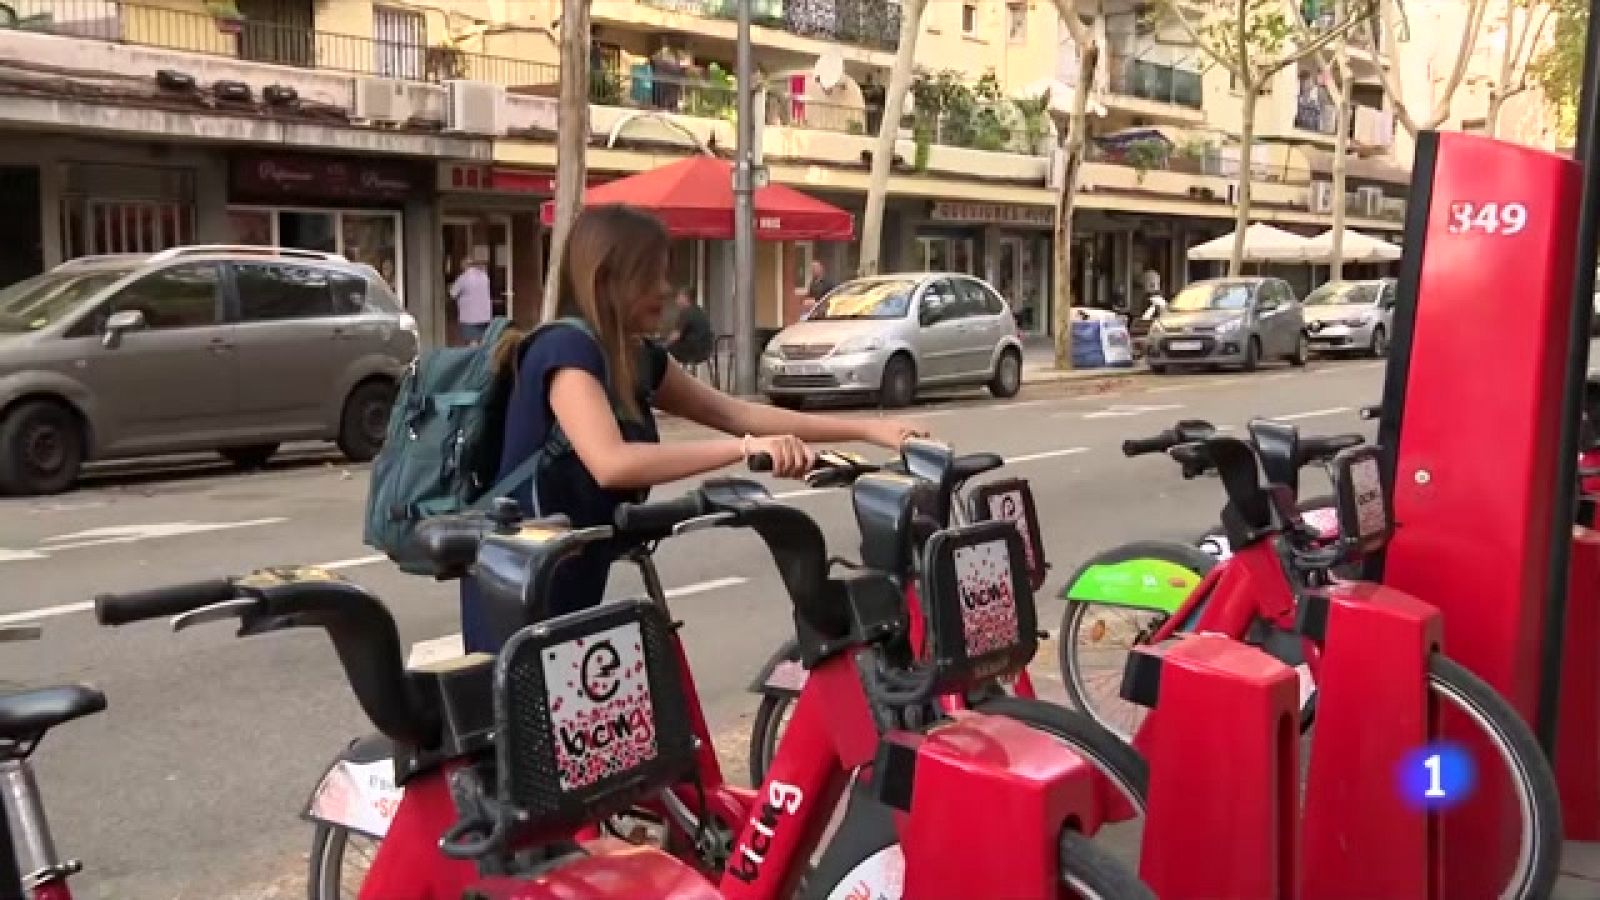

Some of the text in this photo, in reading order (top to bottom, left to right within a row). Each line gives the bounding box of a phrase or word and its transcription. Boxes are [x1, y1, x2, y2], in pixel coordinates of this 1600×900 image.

[1448, 202, 1527, 235] 349
[559, 709, 651, 756] bicing
[729, 780, 804, 885] bicing
